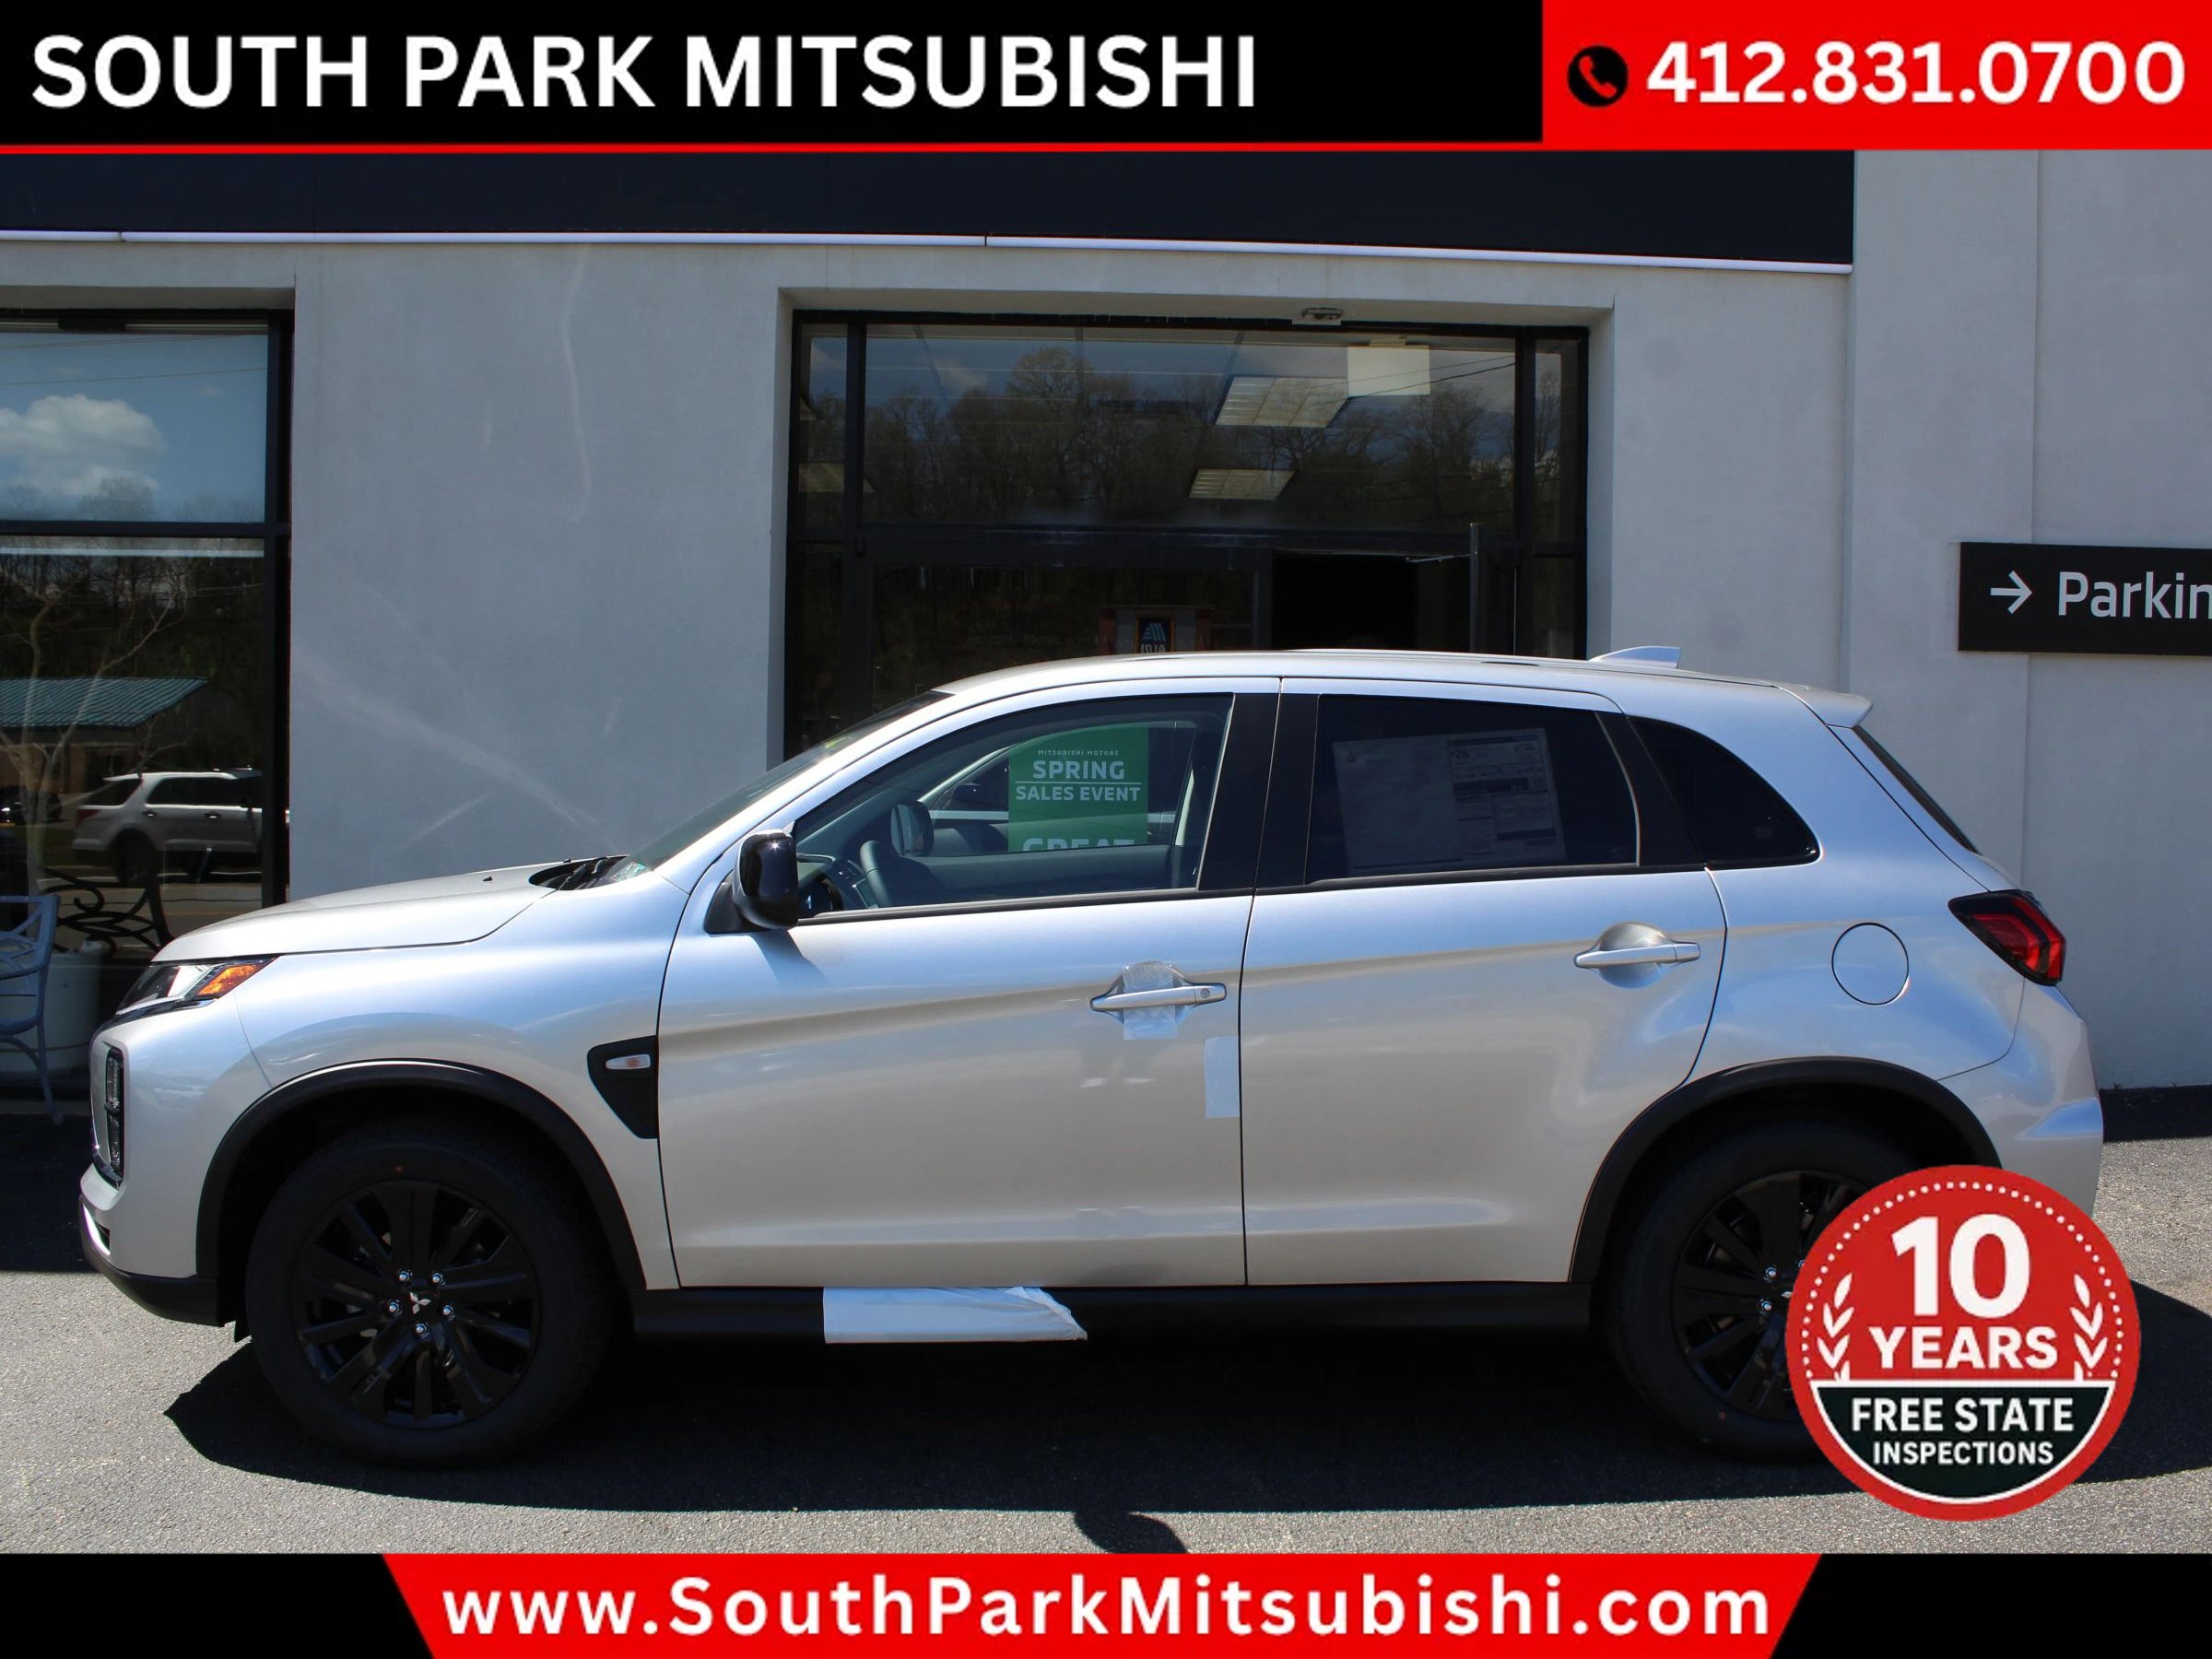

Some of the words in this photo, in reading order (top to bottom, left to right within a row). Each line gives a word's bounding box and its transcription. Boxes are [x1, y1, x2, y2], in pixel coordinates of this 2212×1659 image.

[1032, 759, 1125, 780] SPRING
[1016, 785, 1075, 801] SALES
[1079, 786, 1142, 802] EVENT
